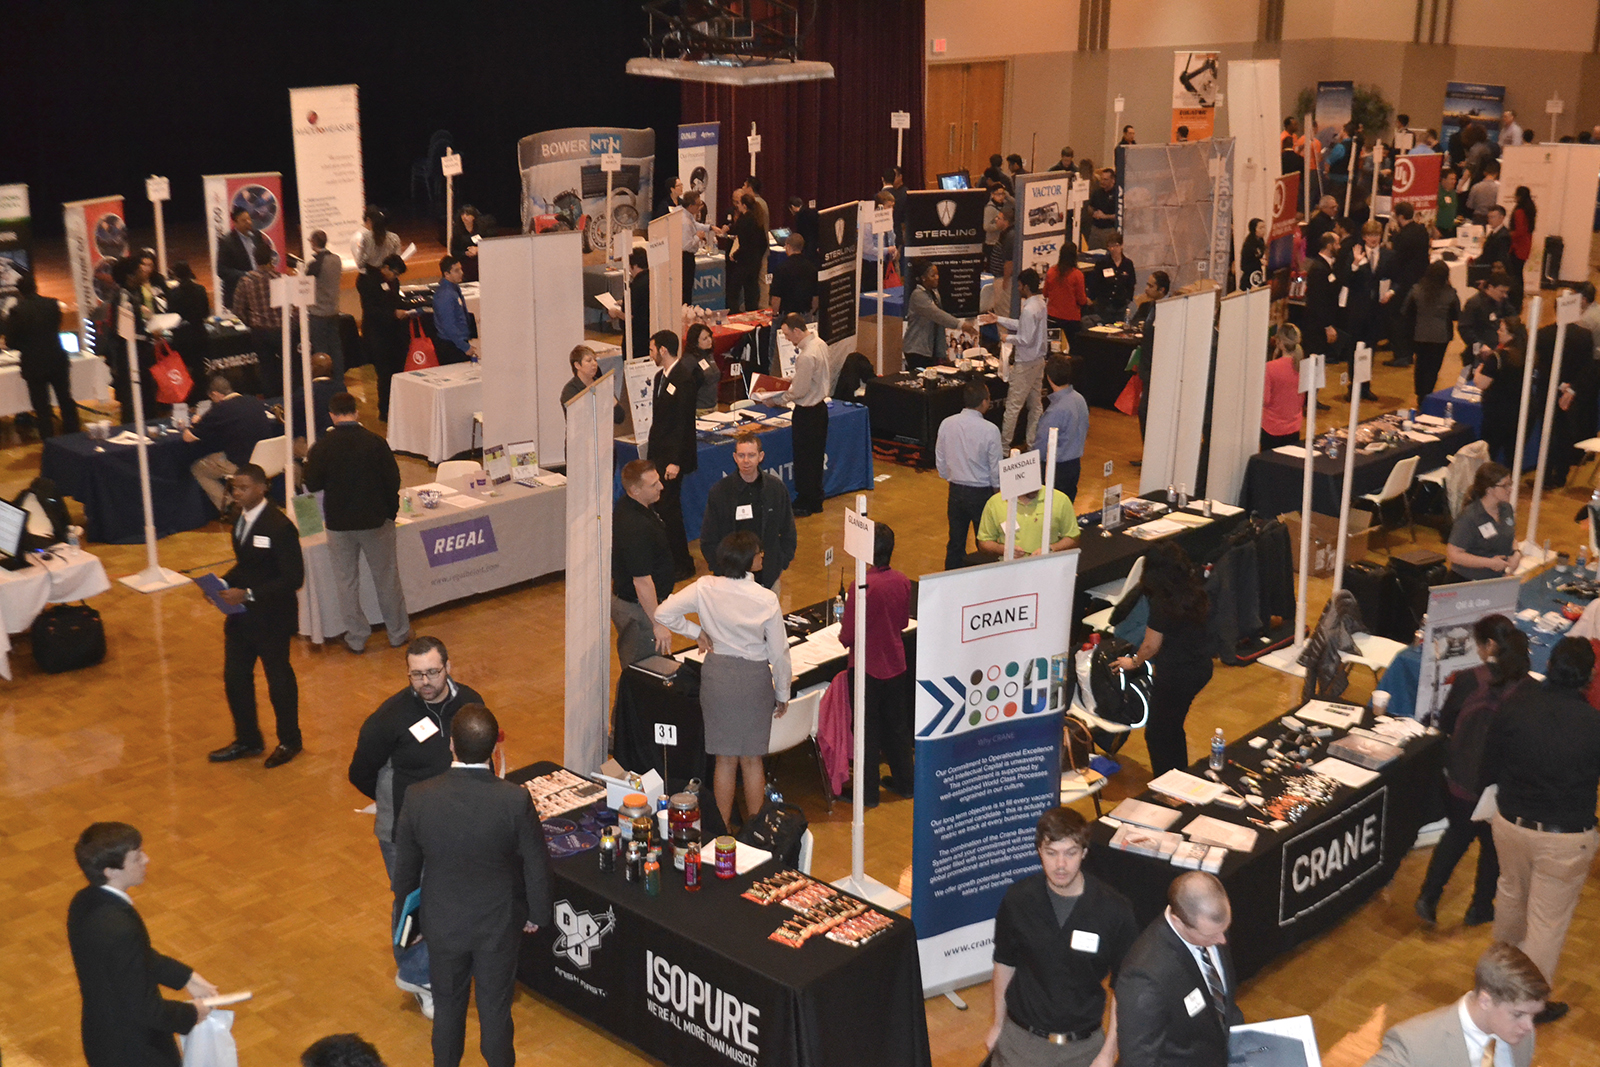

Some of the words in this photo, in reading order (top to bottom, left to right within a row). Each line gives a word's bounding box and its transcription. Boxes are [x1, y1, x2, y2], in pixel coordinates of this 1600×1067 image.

[541, 139, 588, 156] BOWER
[590, 138, 620, 150] NTN
[1032, 185, 1062, 198] VACTOR
[915, 228, 976, 238] STERLING
[824, 245, 856, 260] STERLING
[1033, 244, 1056, 254] HXX
[694, 274, 721, 290] NTN
[1003, 456, 1036, 473] BARKSDALE
[1014, 472, 1026, 480] INC
[848, 515, 869, 532] GLANBIA
[434, 529, 484, 554] REGAL
[970, 606, 1028, 630] CRANE
[658, 725, 672, 738] 31
[936, 770, 947, 778] Our
[948, 759, 981, 774] Commitment
[988, 750, 1021, 763] Operational
[1022, 745, 1054, 756] Excellence
[943, 775, 954, 784] and
[954, 767, 982, 781] Intellectual
[984, 762, 1004, 773] Capital
[950, 781, 960, 790] This
[961, 772, 994, 786] commitment
[1001, 764, 1030, 778] supported
[982, 778, 999, 788] World
[1000, 774, 1016, 784] Class
[1017, 770, 1048, 780] Processes
[960, 790, 986, 803] engrained
[930, 820, 942, 828] Our
[942, 816, 954, 824] long
[955, 812, 968, 820] term
[968, 805, 992, 816] objective
[1014, 796, 1030, 804] every
[1031, 792, 1054, 802] vacancy
[974, 810, 1002, 822] candidate
[1024, 800, 1046, 810] actually
[940, 830, 957, 840] metric
[966, 824, 980, 832] track
[988, 819, 1002, 827] every
[1004, 812, 1030, 822] business
[950, 839, 982, 854] combination
[999, 830, 1017, 839] Crane
[932, 856, 952, 867] System
[953, 852, 964, 860] and
[964, 848, 976, 858] your
[976, 840, 1010, 852] commitment
[934, 864, 952, 874] career
[978, 848, 1006, 860] continuing
[1006, 842, 1035, 853] education
[1292, 814, 1377, 894] CRANE
[930, 874, 946, 884] global
[946, 863, 978, 878] promotional
[978, 860, 990, 868] and
[990, 854, 1012, 864] transfer
[934, 890, 944, 898] We
[944, 886, 957, 894] offer
[957, 879, 976, 890] growth
[976, 872, 1000, 884] potential
[1000, 869, 1012, 878] and
[962, 887, 979, 896] salary
[979, 883, 990, 891] and
[646, 950, 760, 1054] ISOPURE
[647, 998, 669, 1022] WE'RE
[670, 1014, 682, 1031] ALL
[684, 1020, 706, 1042] MORE
[706, 1030, 725, 1054] THAN
[725, 1042, 758, 1067] MUSCLE
